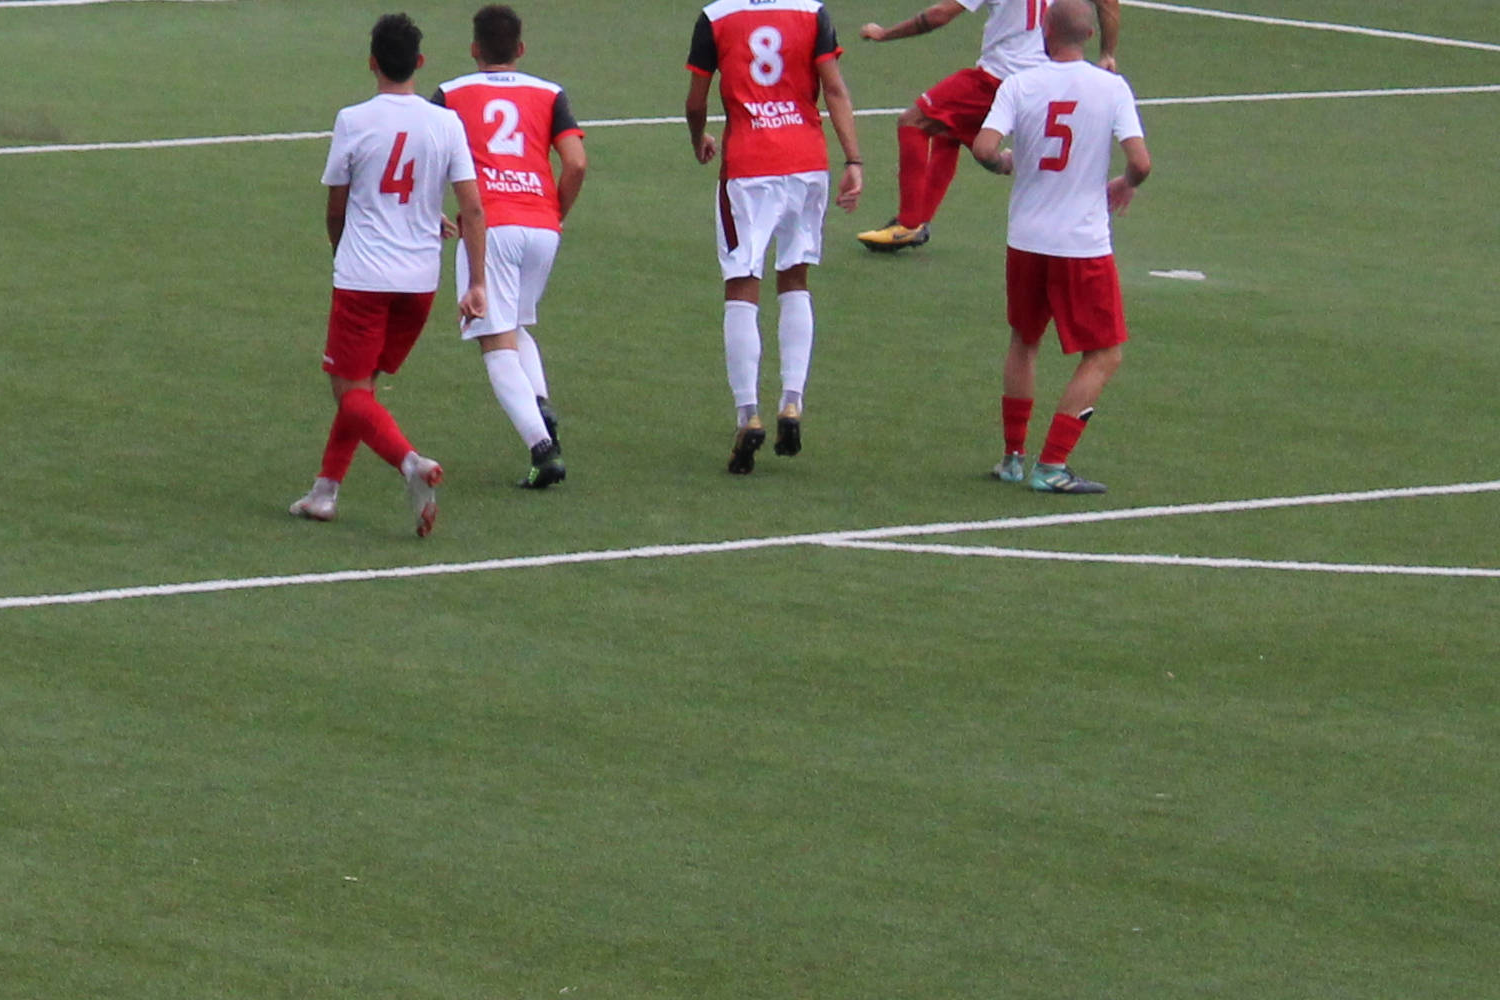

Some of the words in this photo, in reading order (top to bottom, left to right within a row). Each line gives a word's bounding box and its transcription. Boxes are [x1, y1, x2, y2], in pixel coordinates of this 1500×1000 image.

[748, 25, 784, 86] 8
[483, 98, 525, 157] 2
[1038, 101, 1079, 172] 5
[379, 131, 416, 204] 4
